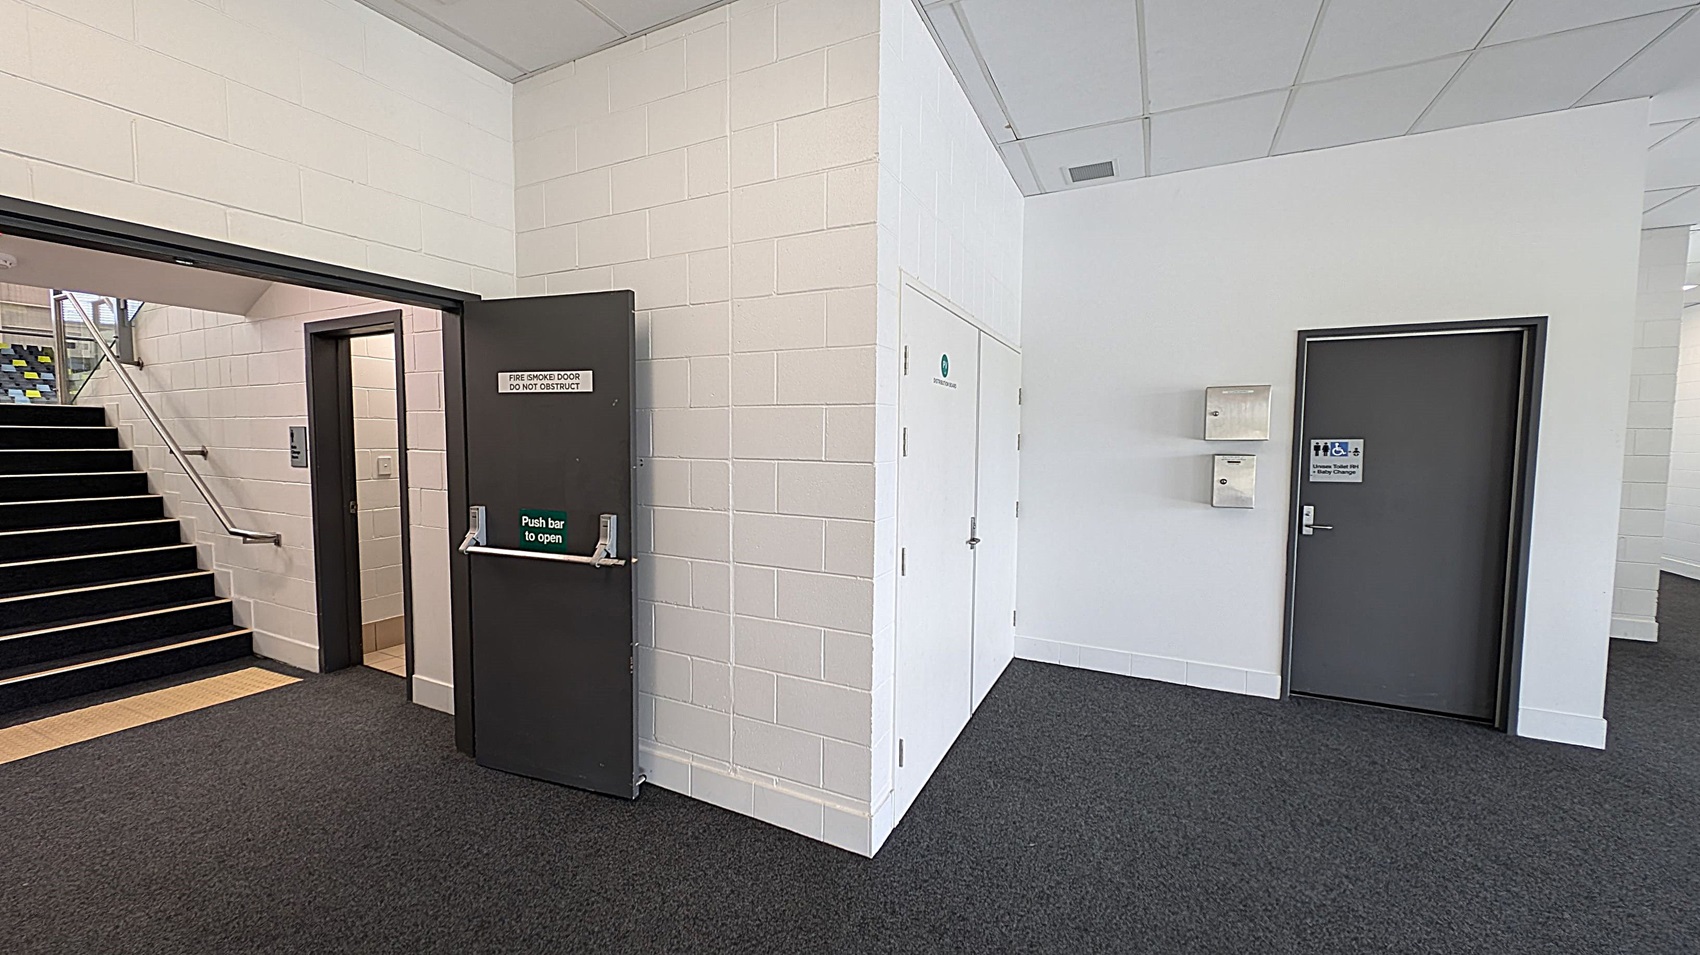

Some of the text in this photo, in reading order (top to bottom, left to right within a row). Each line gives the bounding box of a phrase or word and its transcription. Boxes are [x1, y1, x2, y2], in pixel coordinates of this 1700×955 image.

[526, 373, 555, 381] (SMOKE)
[521, 515, 565, 529] Push bar
[524, 530, 563, 545] to open
